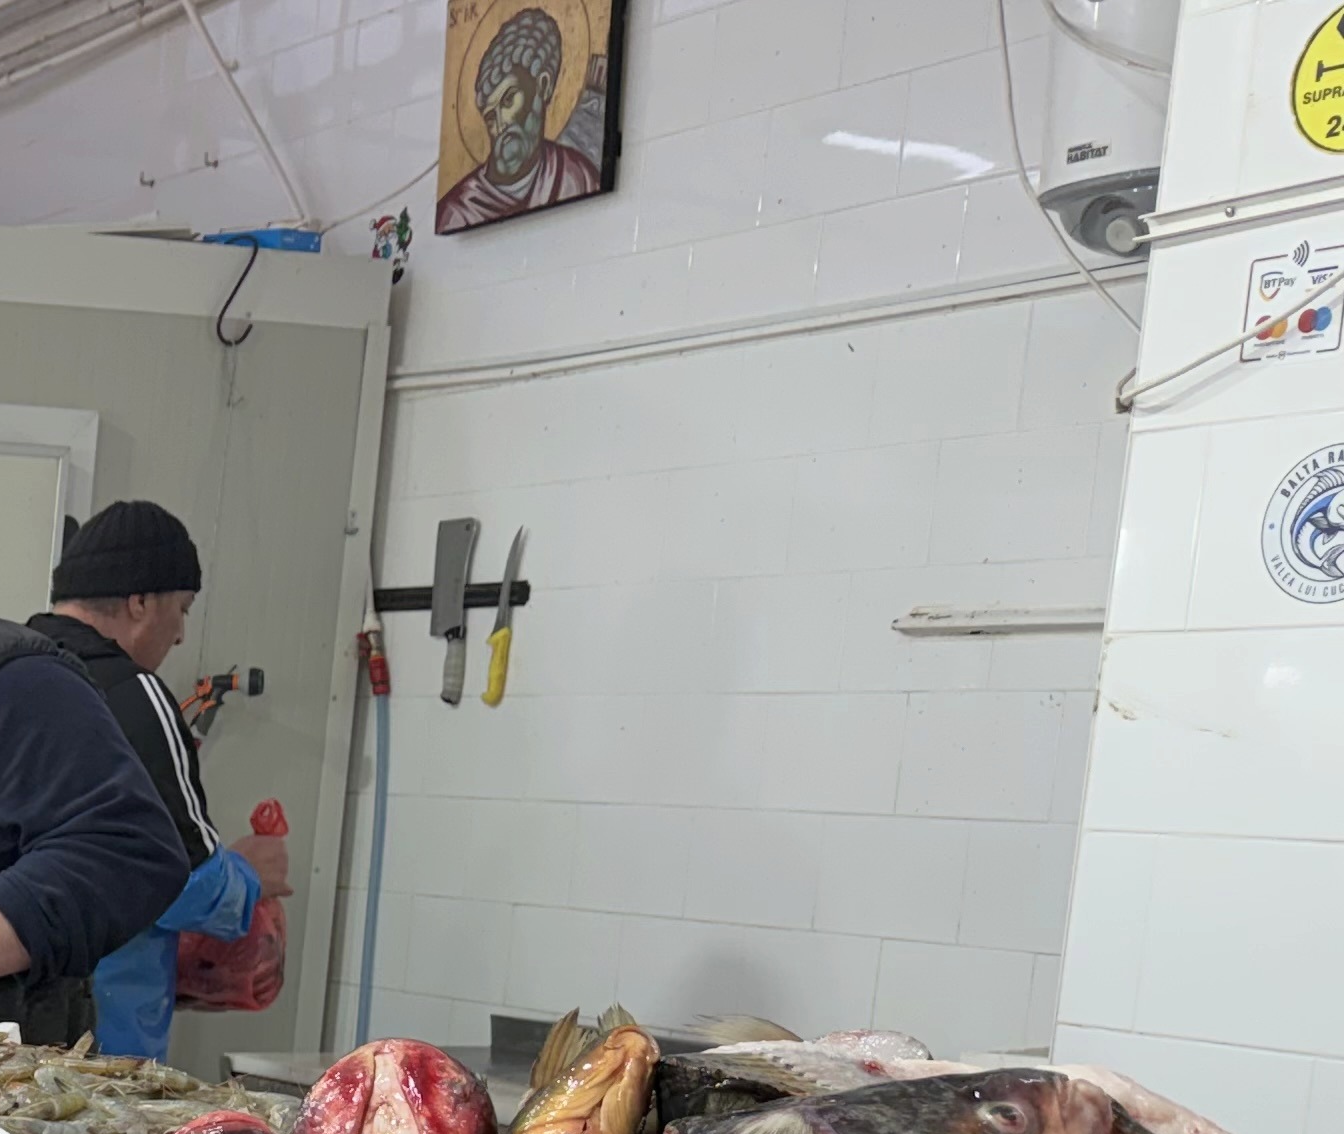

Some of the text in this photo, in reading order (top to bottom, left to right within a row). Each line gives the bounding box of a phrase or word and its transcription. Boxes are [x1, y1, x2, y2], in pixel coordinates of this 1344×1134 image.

[1302, 85, 1344, 105] SUPR
[1325, 115, 1344, 138] 2
[1280, 458, 1320, 498] BALTA
[1270, 554, 1296, 587] VALEA
[1297, 582, 1317, 597] LUI
